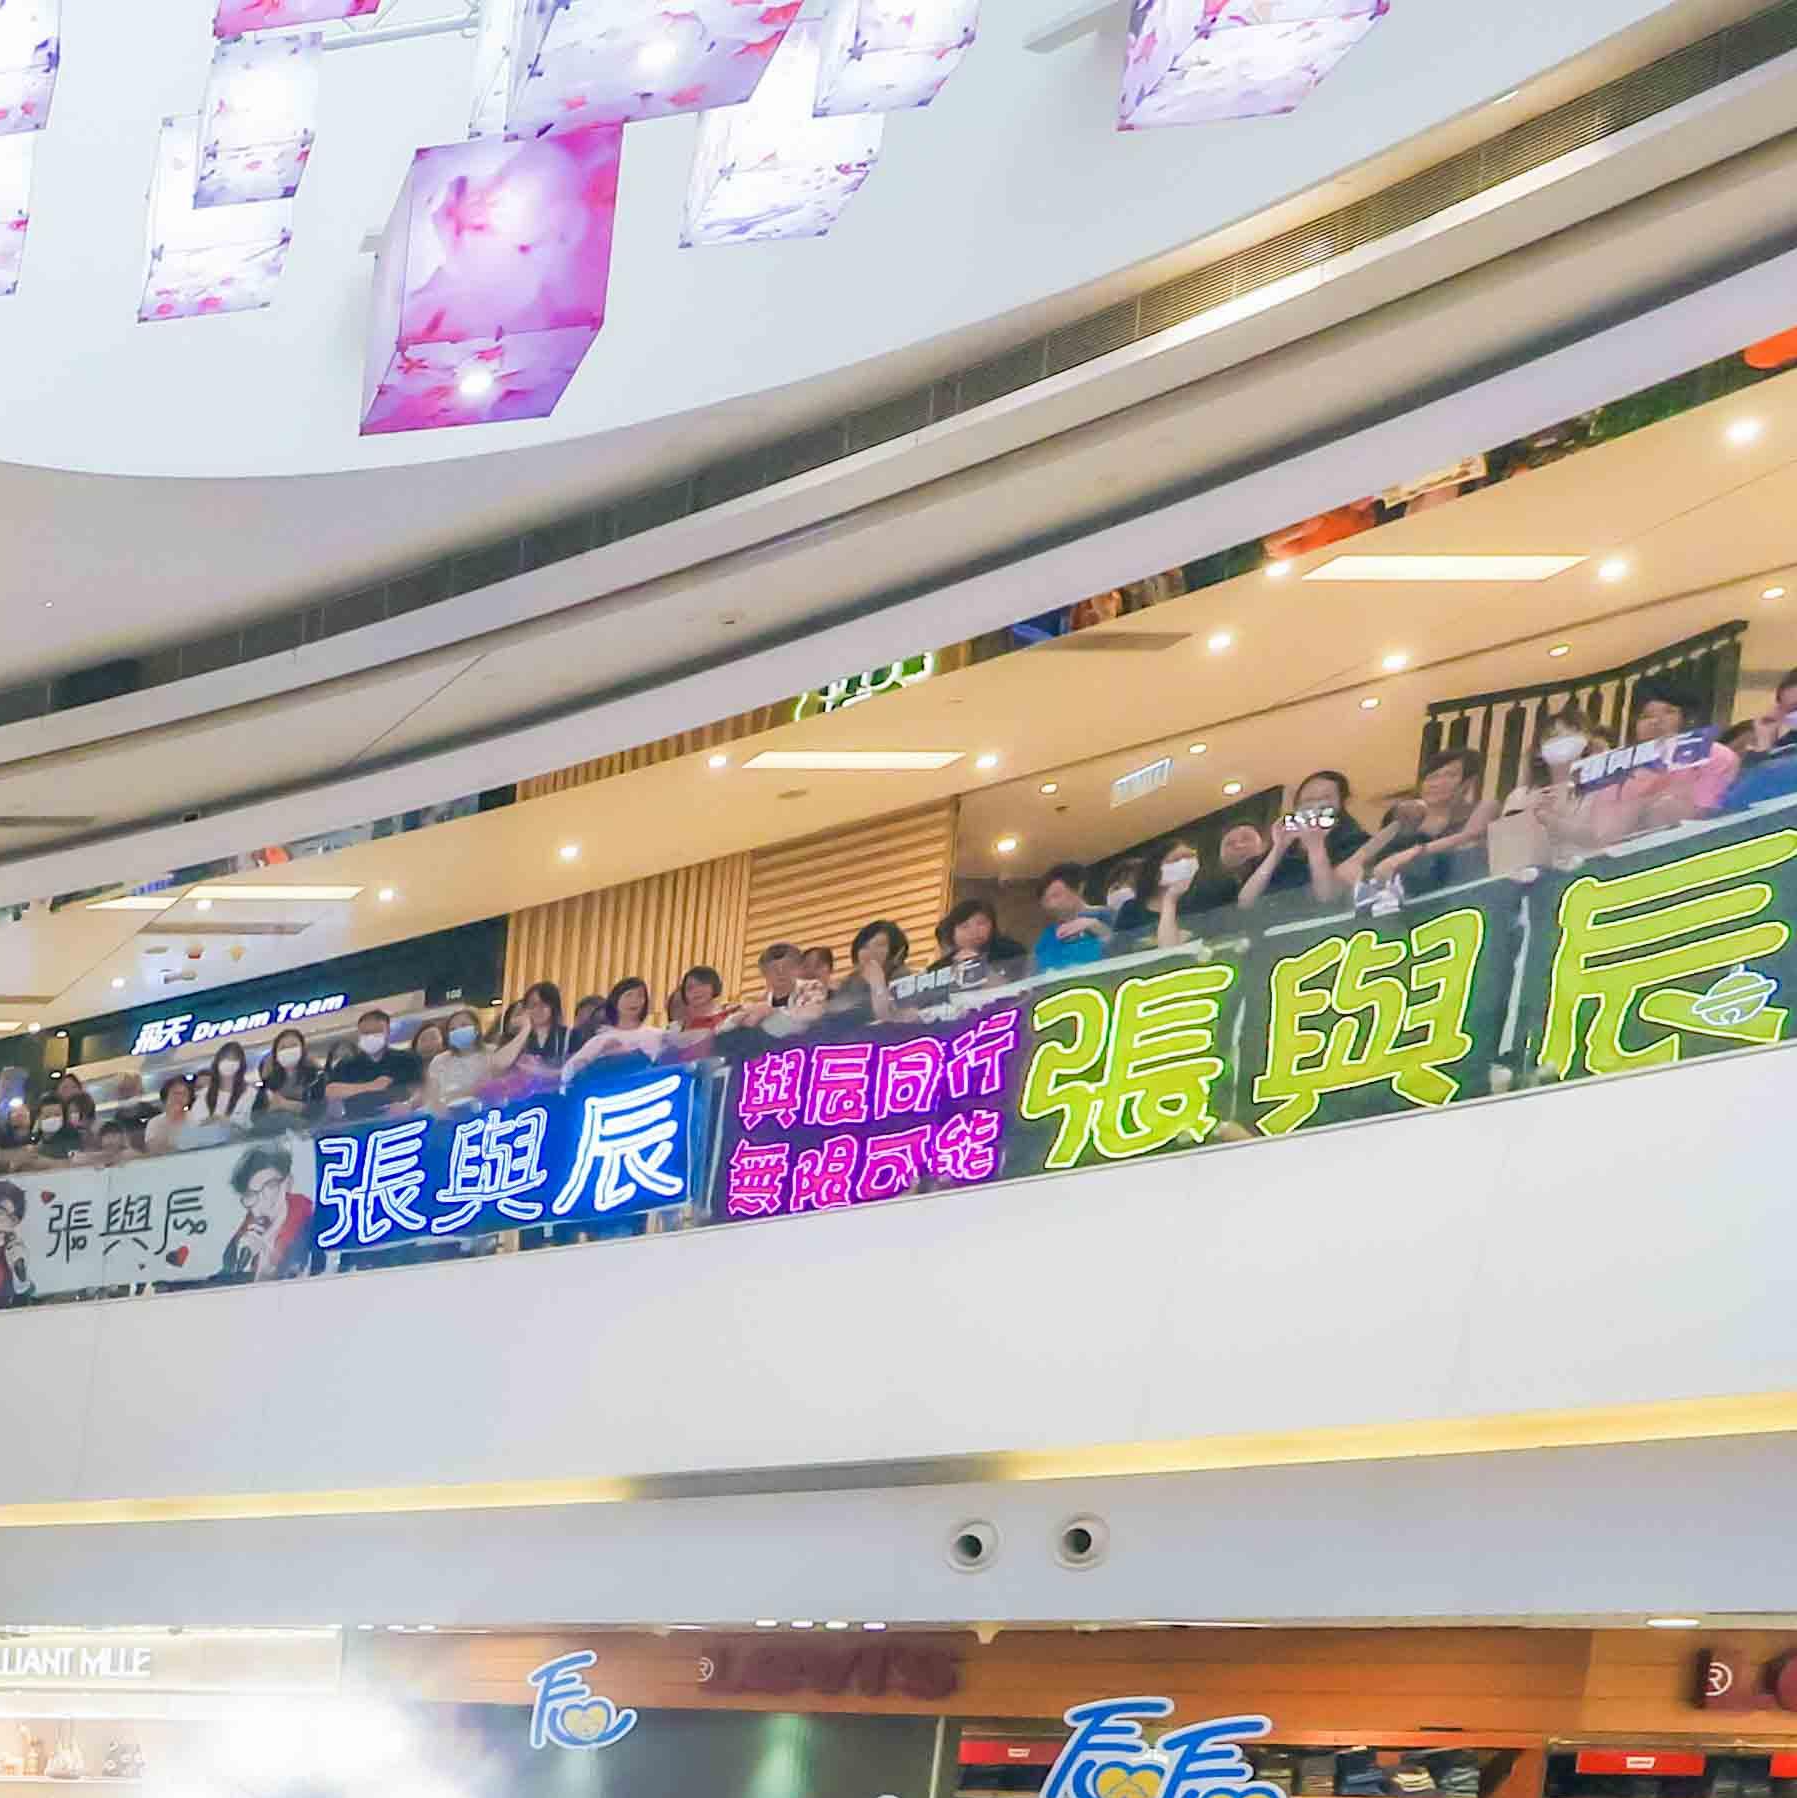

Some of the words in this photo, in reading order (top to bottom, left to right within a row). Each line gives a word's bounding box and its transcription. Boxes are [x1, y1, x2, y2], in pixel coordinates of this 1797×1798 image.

[131, 1014, 193, 1056] 飛天
[193, 1010, 269, 1042] Dream
[275, 993, 347, 1028] Team
[1018, 830, 1797, 1169] 張與辰
[736, 1009, 1018, 1130] 與辰同行
[316, 1074, 686, 1248] 張與辰
[727, 1110, 1002, 1217] 無限可能
[47, 1184, 207, 1262] 張與辰
